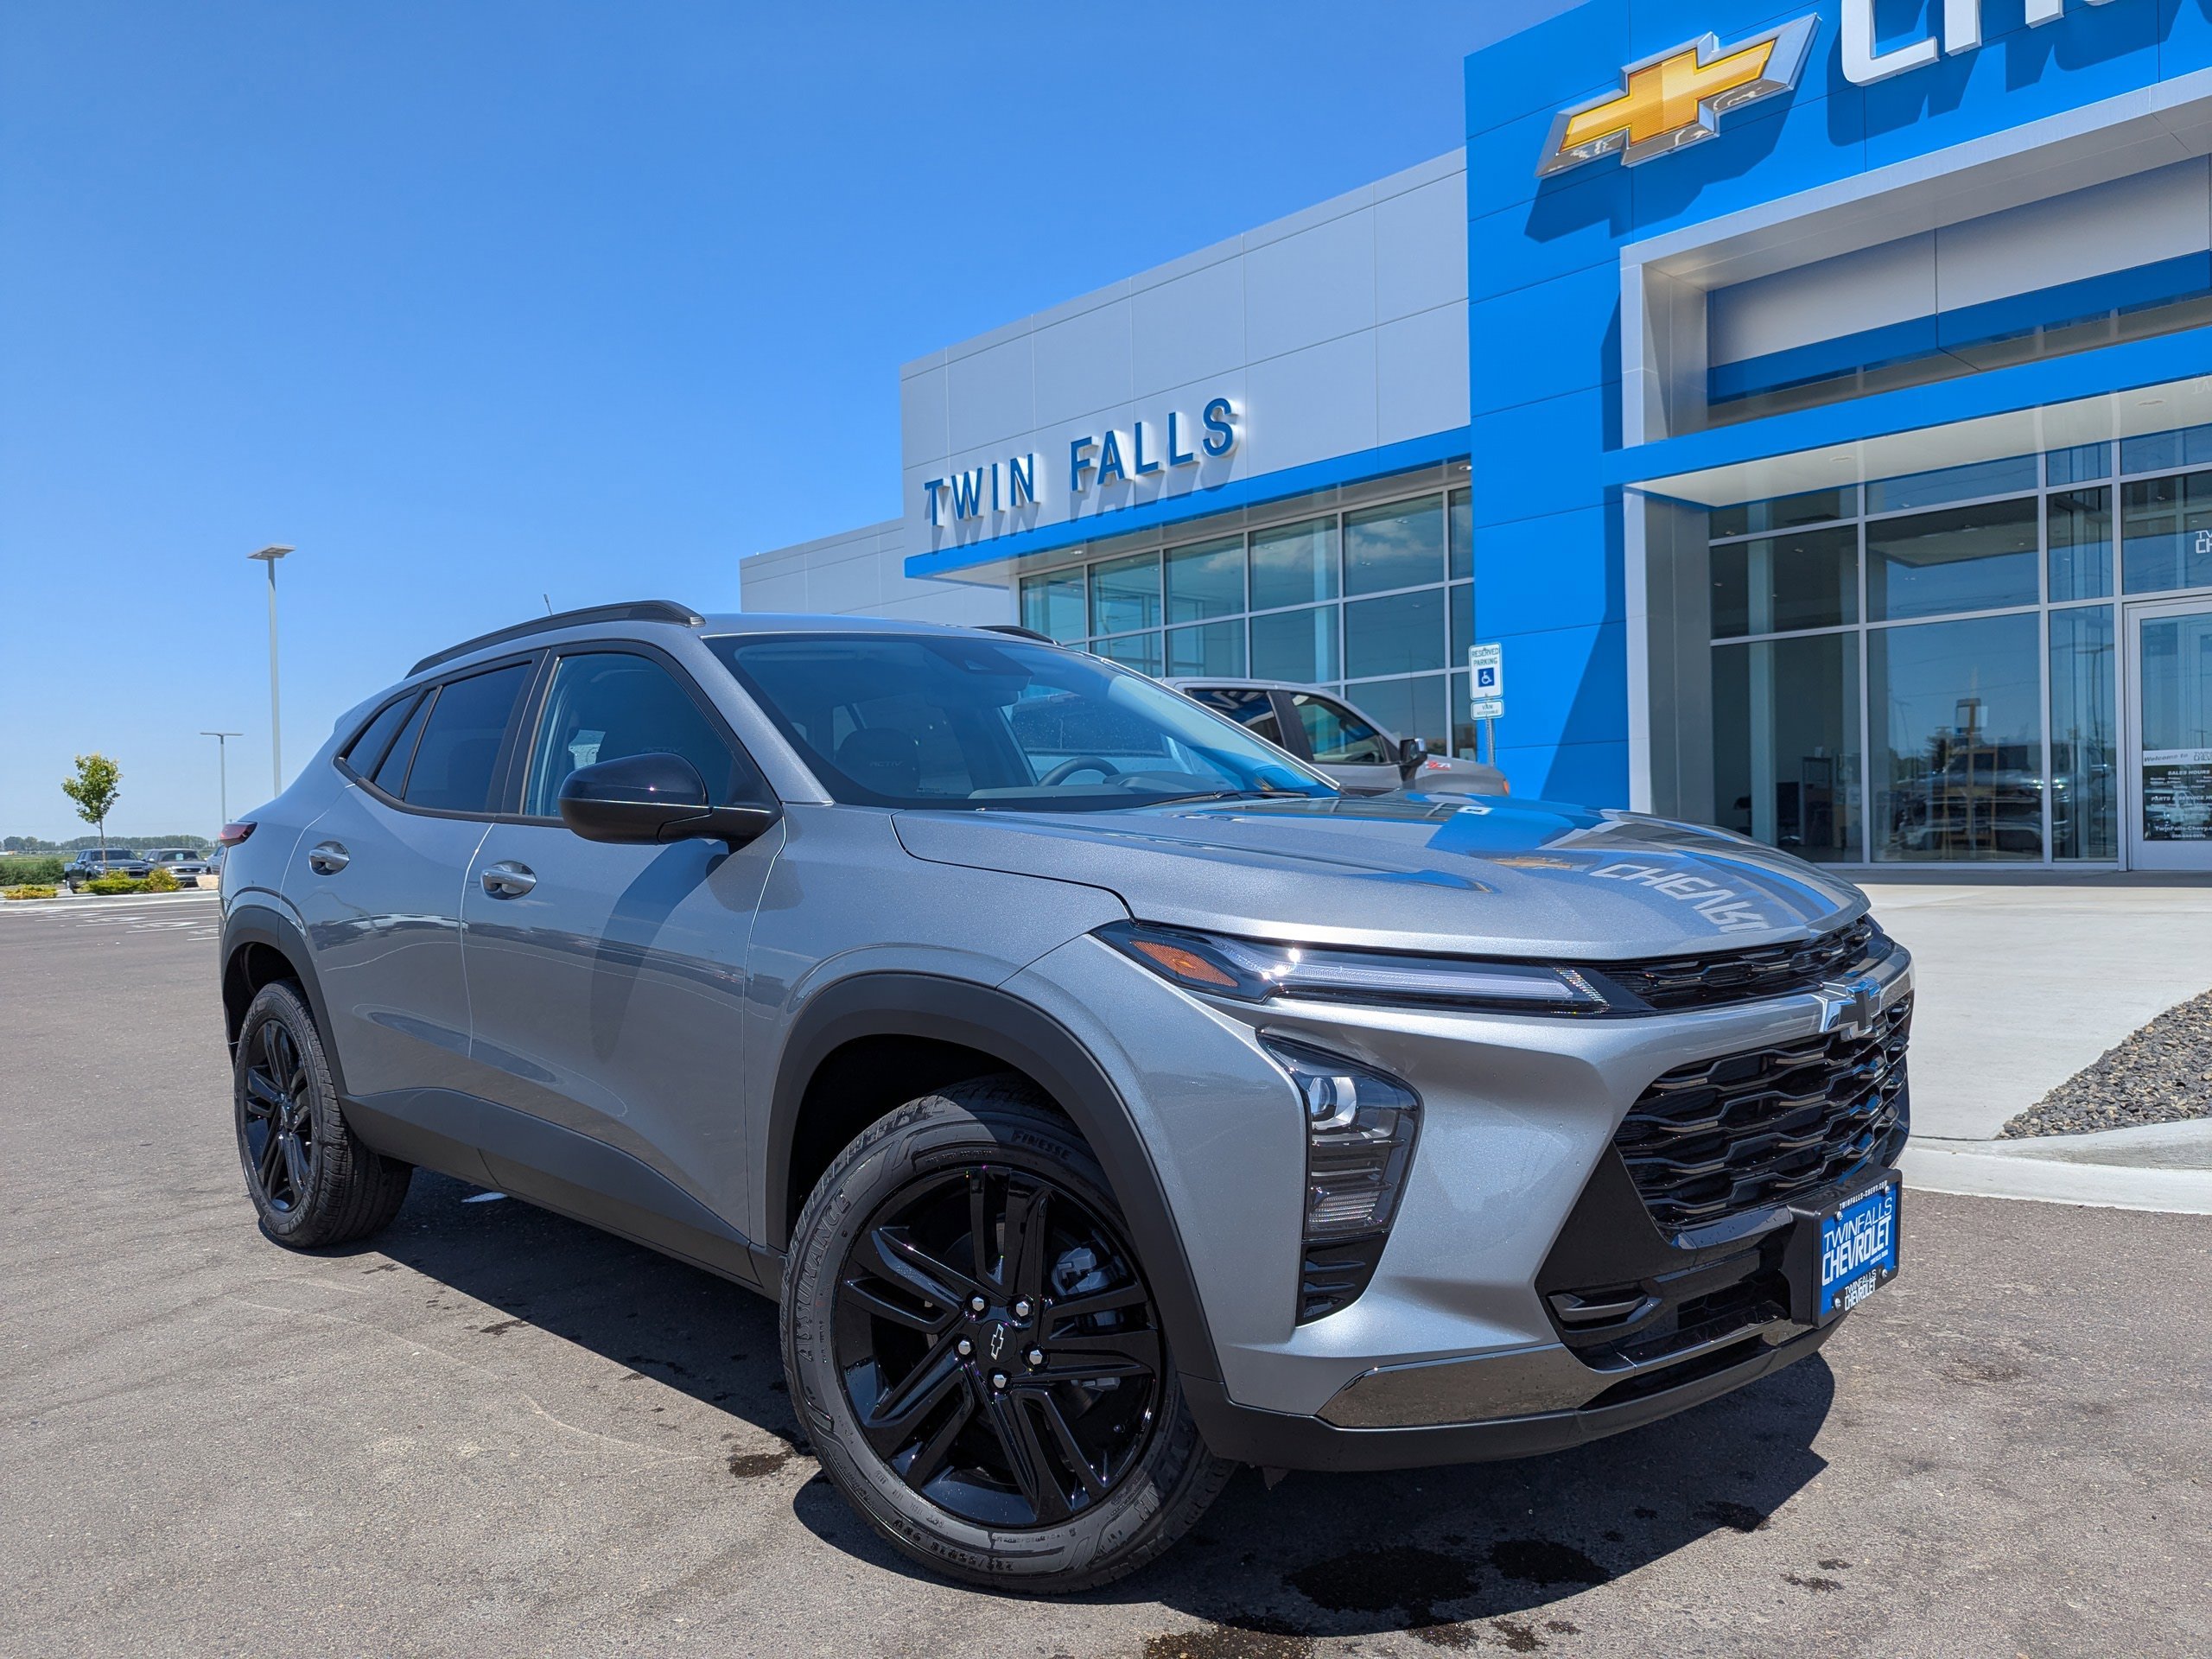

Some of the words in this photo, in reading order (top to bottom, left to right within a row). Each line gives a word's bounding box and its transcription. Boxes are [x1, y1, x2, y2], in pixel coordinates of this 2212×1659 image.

[923, 452, 1040, 528] TWIN
[1070, 397, 1241, 493] FALLS
[1471, 647, 1500, 658] RESERVED
[1473, 658, 1498, 667] PARKING
[1011, 1128, 1072, 1161] FINESSE
[1821, 1217, 1891, 1287] CHEVROLET
[796, 1188, 851, 1363] ASSURANCE
[1844, 1278, 1877, 1312] CHEVROLET
